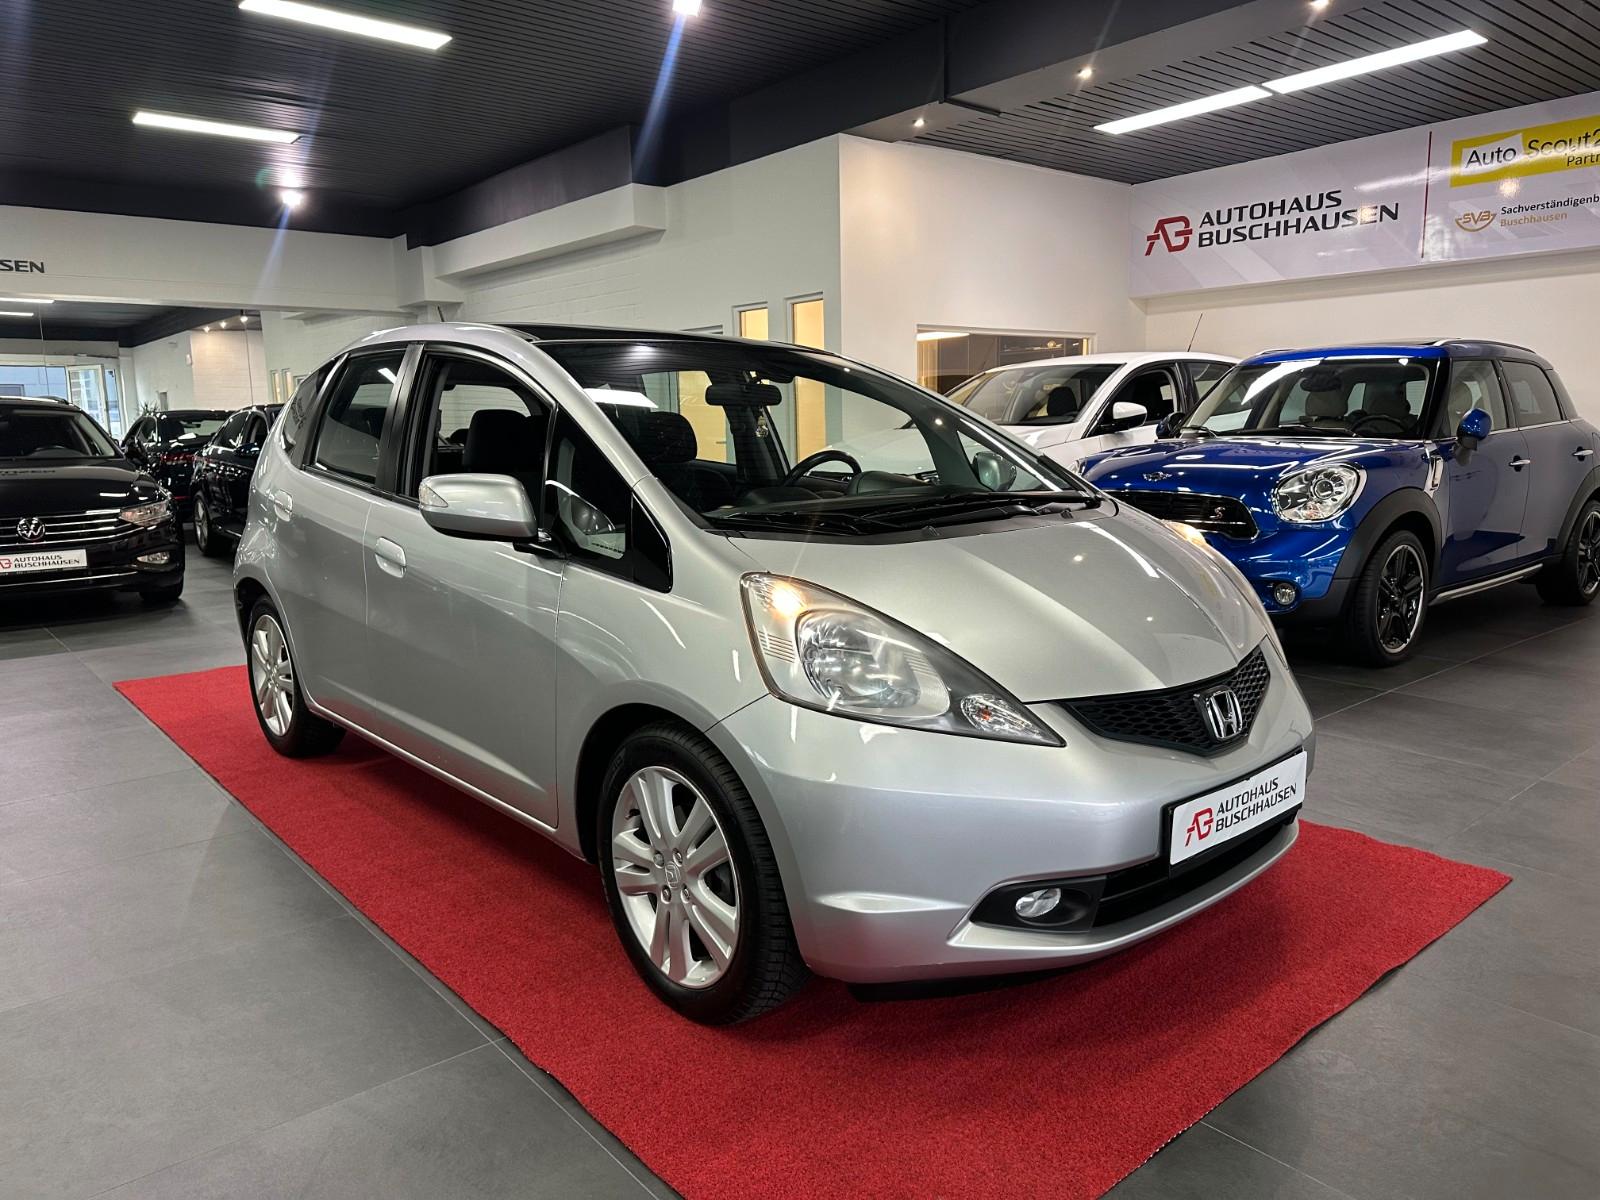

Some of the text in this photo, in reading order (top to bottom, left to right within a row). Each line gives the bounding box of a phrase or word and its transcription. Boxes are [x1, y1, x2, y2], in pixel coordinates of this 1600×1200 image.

[1465, 146, 1517, 169] Auto
[1199, 189, 1342, 228] AUTOHAUS
[1500, 212, 1568, 227] Buschhausen
[1198, 202, 1399, 248] BUSCHHAUSEN
[14, 554, 63, 563] AUTOHAUS
[14, 559, 80, 569] BUSCHHAUSEN
[1215, 783, 1297, 833] BUSCHHAUSEN
[1216, 777, 1279, 816] AUTOHAUS
